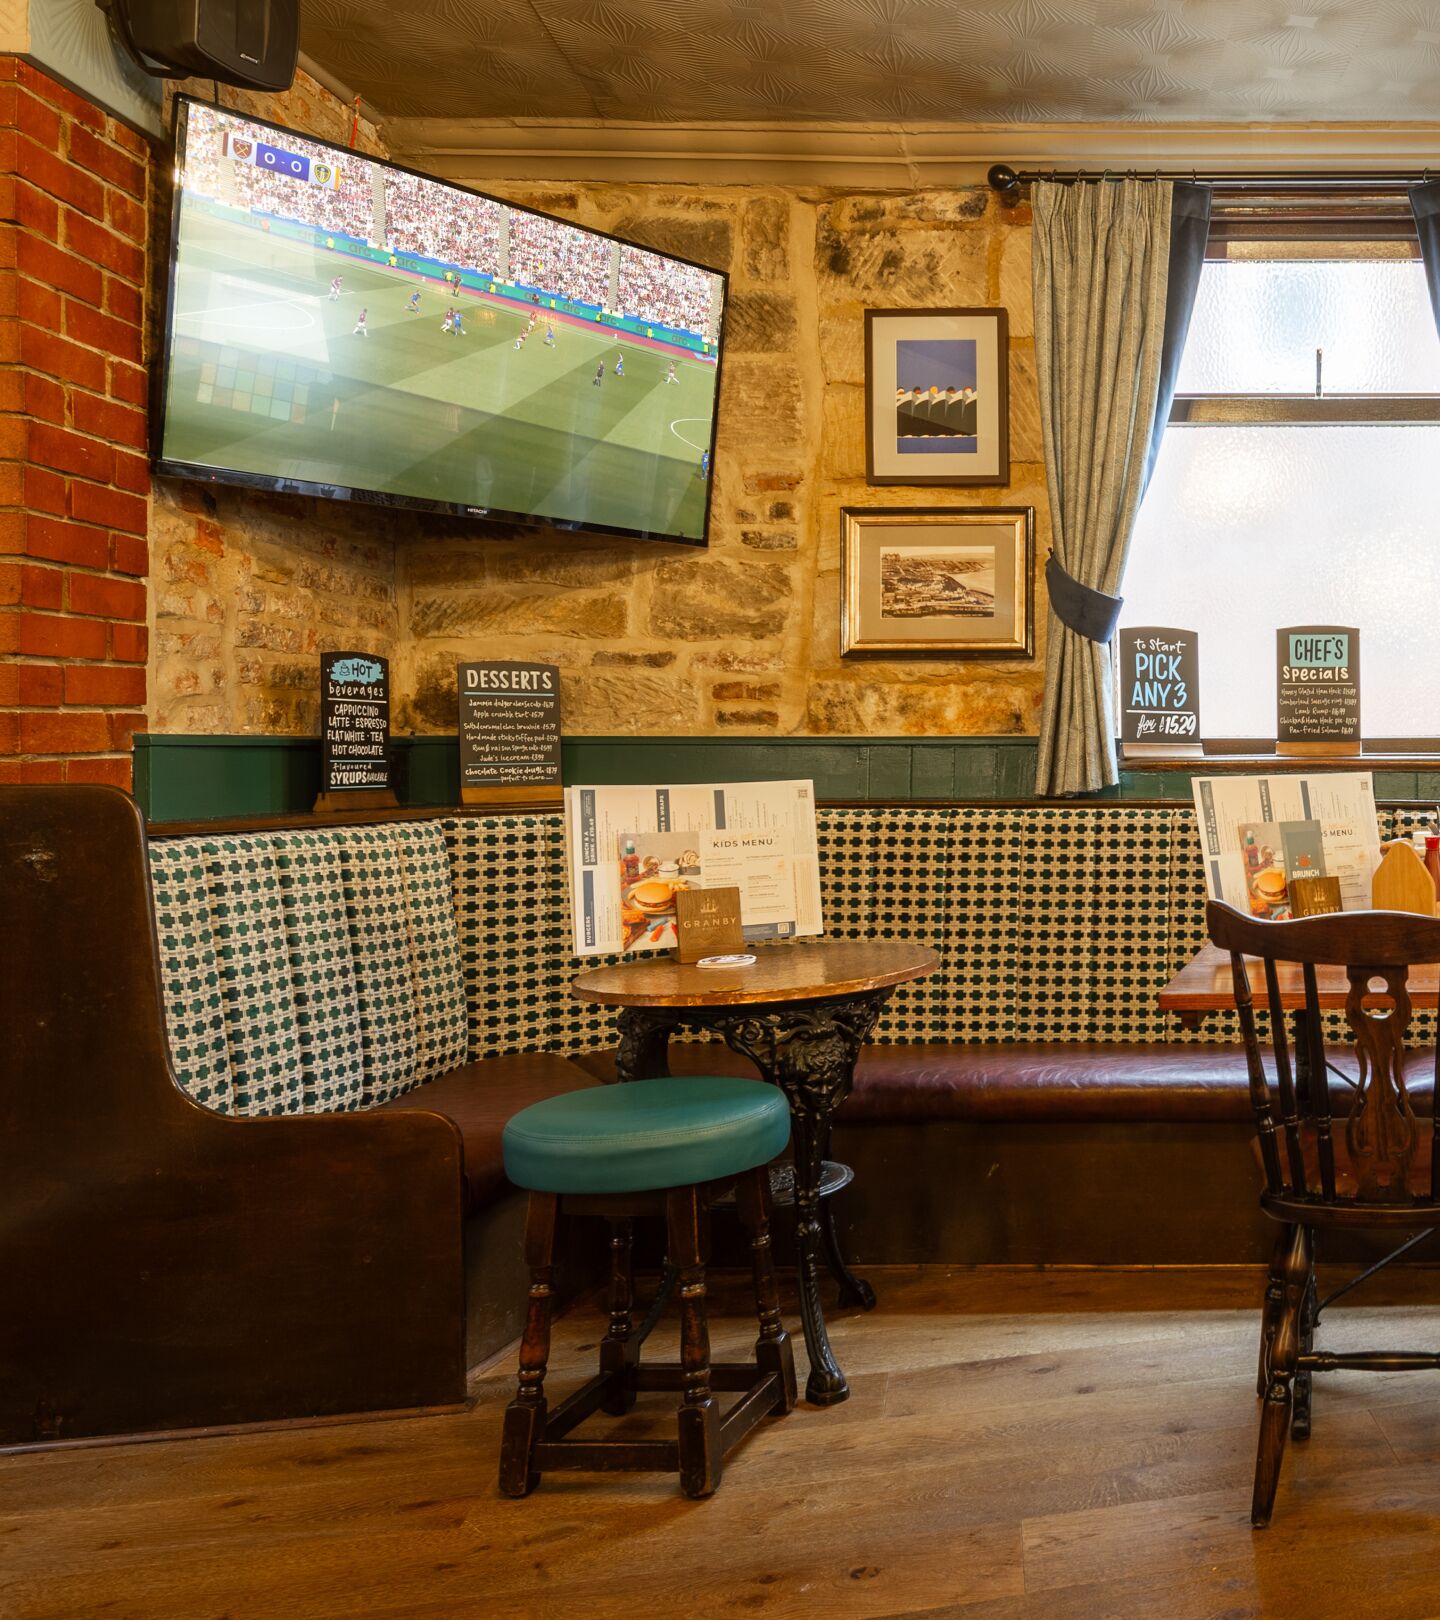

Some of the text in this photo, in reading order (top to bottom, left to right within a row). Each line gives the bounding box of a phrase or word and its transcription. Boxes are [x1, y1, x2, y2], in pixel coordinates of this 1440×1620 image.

[264, 152, 275, 164] 0
[291, 160, 302, 172] 0
[1133, 638, 1147, 651] to
[1294, 636, 1344, 662] CHEF'S
[351, 662, 373, 678] HOT
[1135, 652, 1182, 681] PICK
[466, 669, 553, 690] DESSERTS
[1282, 665, 1349, 682] Specials
[329, 682, 384, 699] beverages
[1131, 681, 1188, 708] ANY 3
[334, 704, 379, 717] CAPPUCCINO
[473, 710, 489, 719] Apple
[491, 710, 513, 718] crumble
[515, 710, 529, 718] tart
[1295, 707, 1310, 715] Lamb
[1312, 707, 1329, 715] Rump
[328, 716, 387, 729] LATTE ESPRESSO
[480, 722, 502, 730] caramel
[502, 722, 515, 730] choc
[516, 722, 541, 730] brownie
[1136, 714, 1157, 739] for
[370, 731, 384, 742] TEA
[515, 733, 534, 742] toffee
[534, 733, 545, 743] pud
[332, 744, 384, 756] HOT CHOCOLATE
[332, 762, 373, 771] flavoured
[465, 767, 498, 776] chocolate
[524, 766, 545, 774] dough
[330, 771, 367, 785] SYRUPS
[1330, 828, 1353, 837] MENU
[713, 838, 774, 849] KIDS MENU
[1292, 869, 1320, 878] BRUNCH
[683, 916, 737, 929] GRANBY
